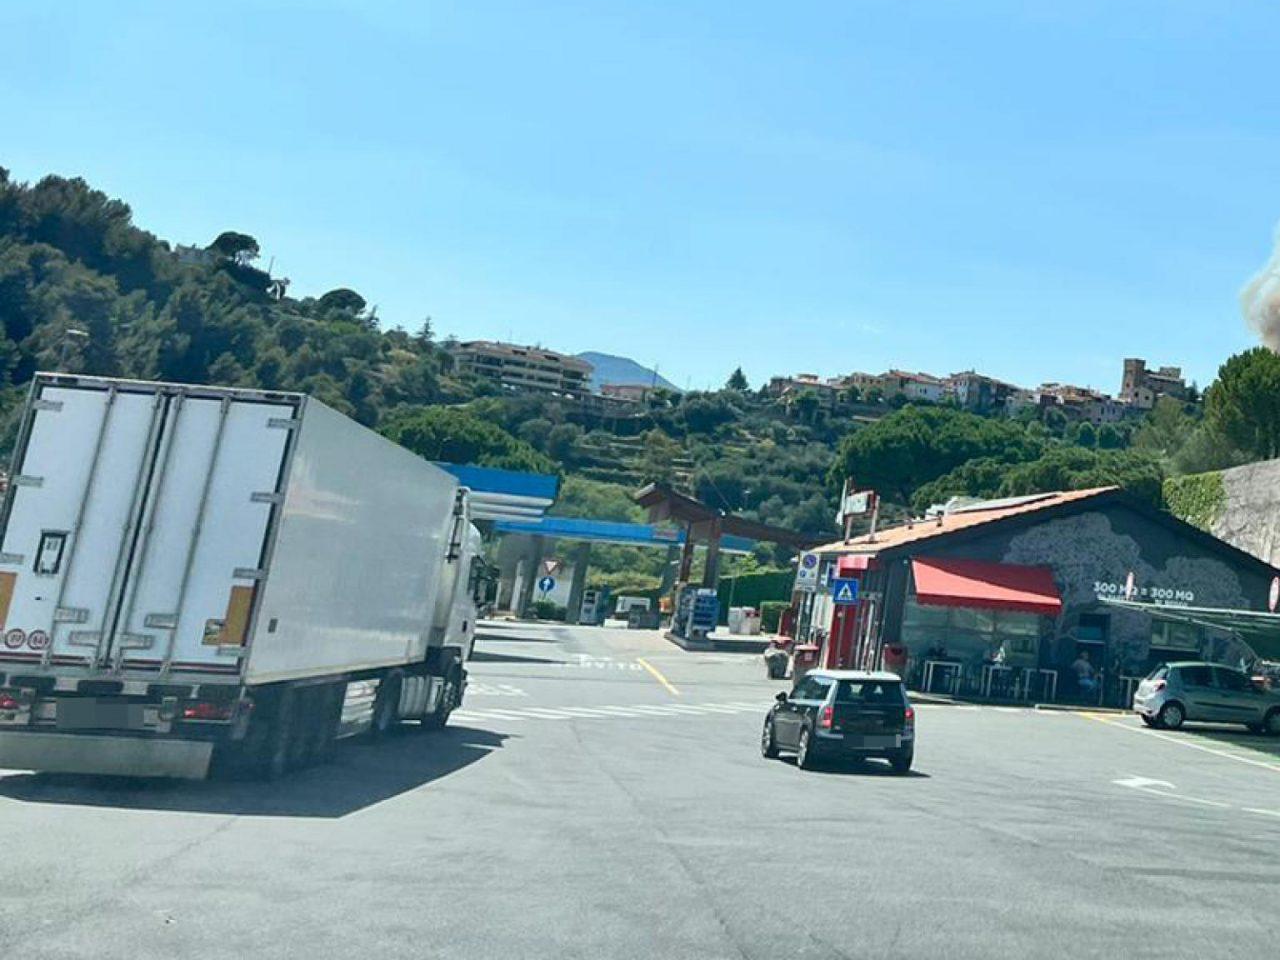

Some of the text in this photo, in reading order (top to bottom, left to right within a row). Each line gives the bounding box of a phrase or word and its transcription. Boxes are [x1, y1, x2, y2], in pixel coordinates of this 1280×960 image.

[1093, 581, 1118, 594] 300
[1150, 586, 1174, 599] 300
[1175, 590, 1195, 601] MQ
